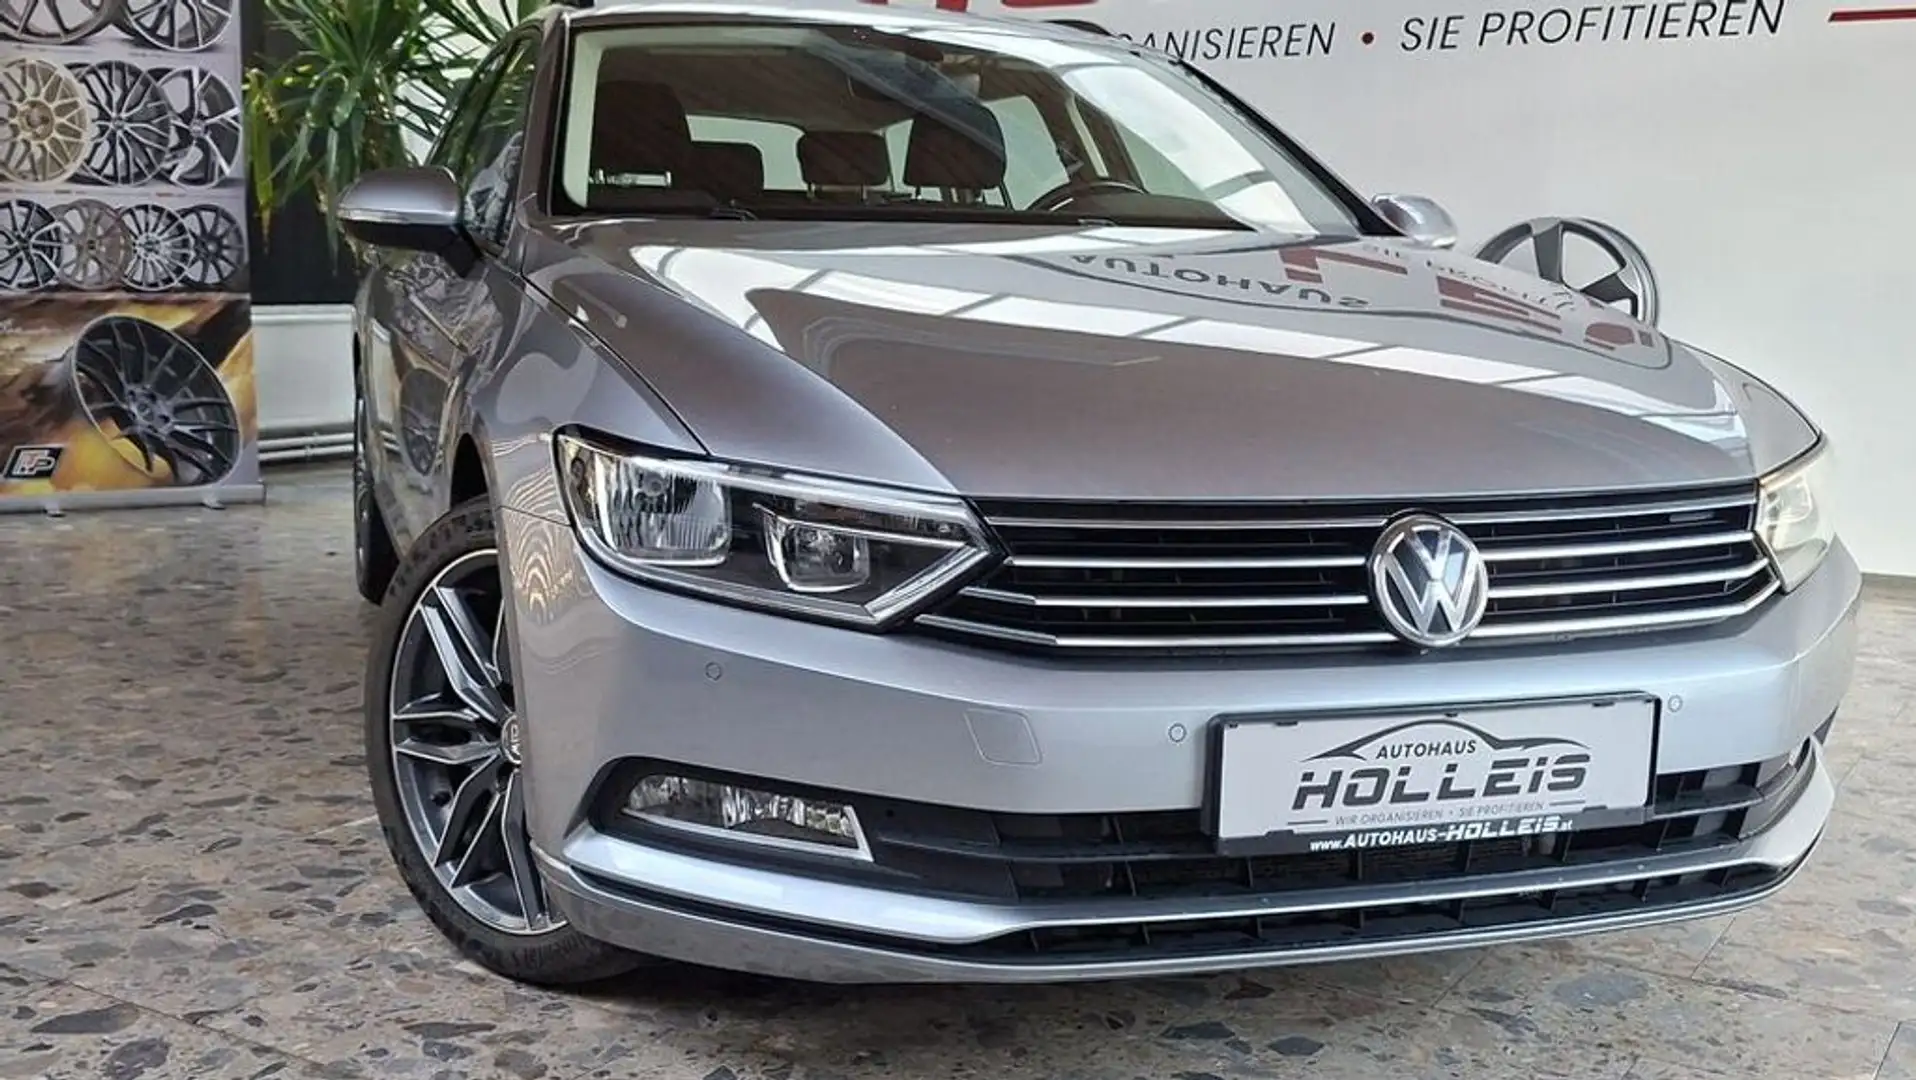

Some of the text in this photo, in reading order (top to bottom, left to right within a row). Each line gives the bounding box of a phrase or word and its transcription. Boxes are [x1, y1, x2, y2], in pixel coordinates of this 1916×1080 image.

[1118, 0, 1785, 61] ANISIEREN SIE PROFITIEREN
[1378, 520, 1485, 641] VW
[1376, 740, 1477, 759] AUTOHAUS
